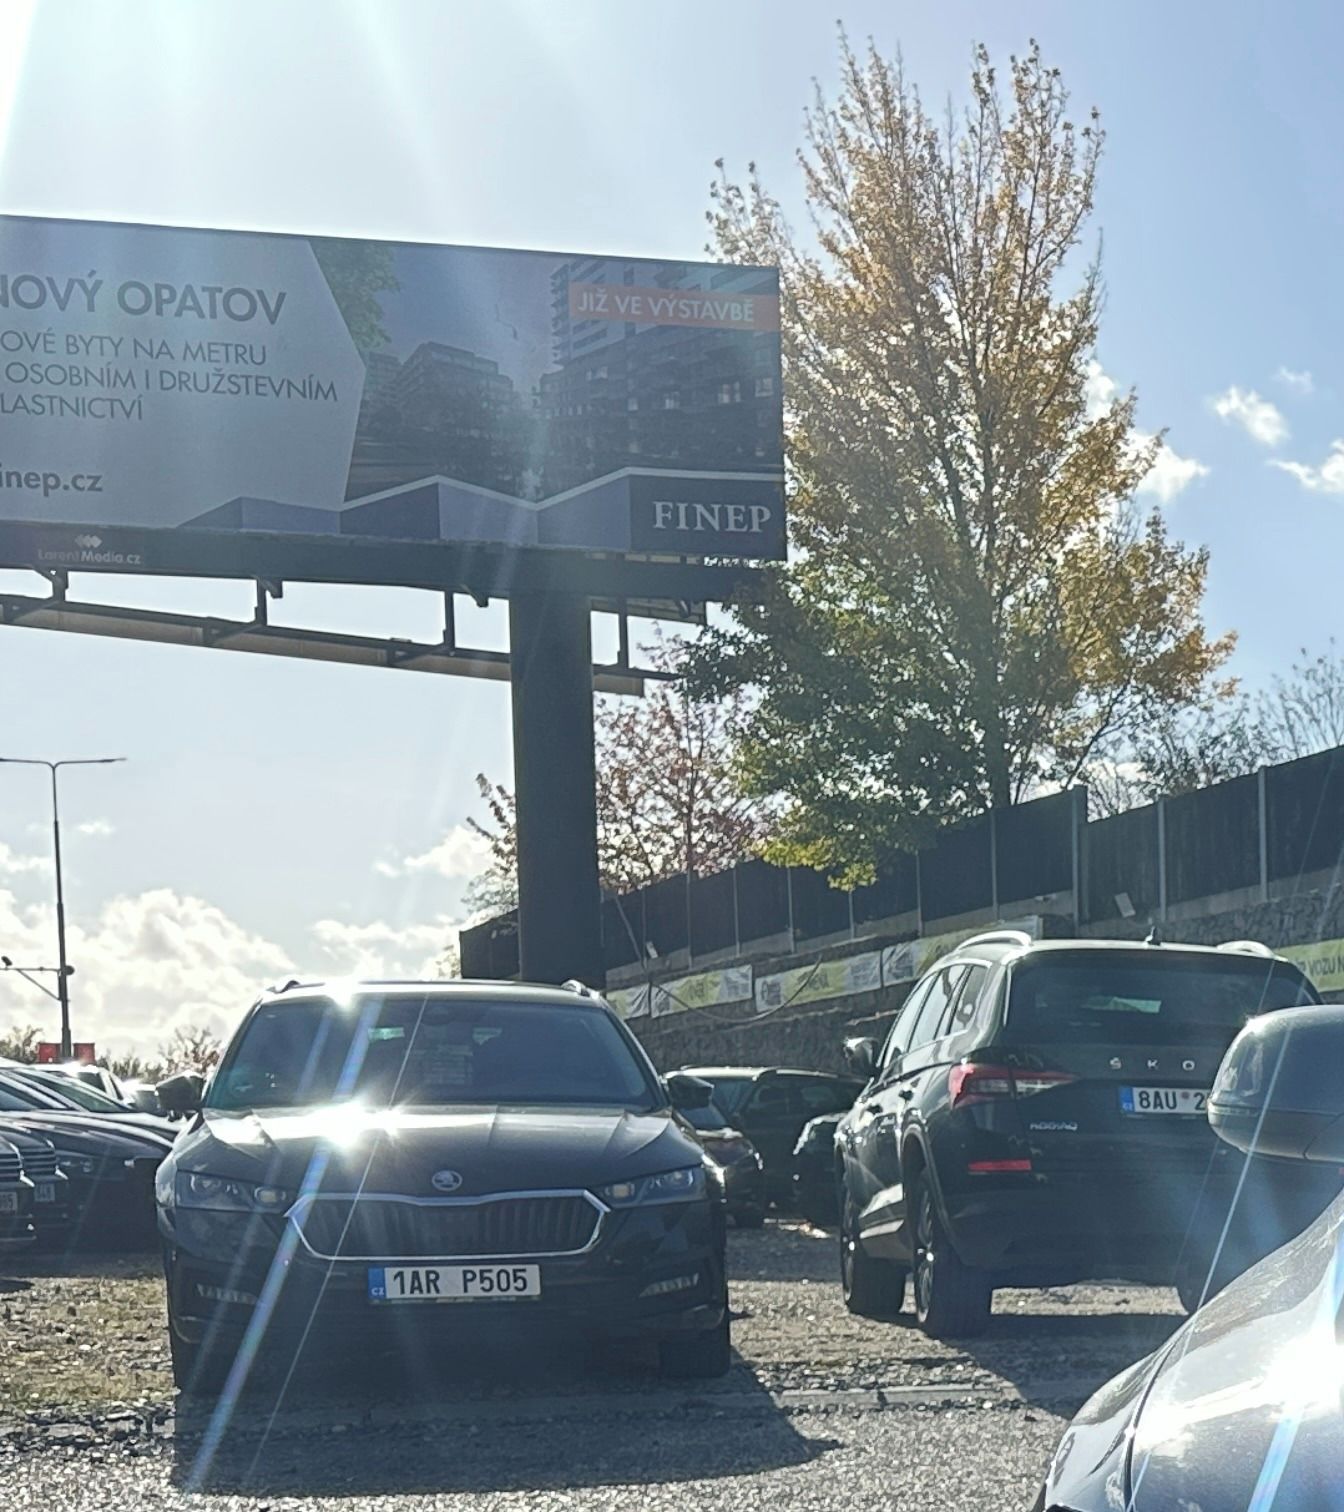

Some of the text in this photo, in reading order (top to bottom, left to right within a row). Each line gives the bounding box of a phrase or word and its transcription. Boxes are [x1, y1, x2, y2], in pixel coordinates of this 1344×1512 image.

[117, 280, 287, 325] OPATOV
[578, 288, 754, 322] JIŽ VE VÝSTAVBĚ
[66, 334, 123, 358] BYTY
[133, 338, 175, 360] NA
[183, 342, 267, 366] METRU
[5, 361, 338, 402] OSOBNÍM I DRUŽSTEVNÍM
[652, 501, 771, 532] FINEP
[1138, 1090, 1177, 1110] 8AU
[393, 1268, 528, 1295] 1AR P505
